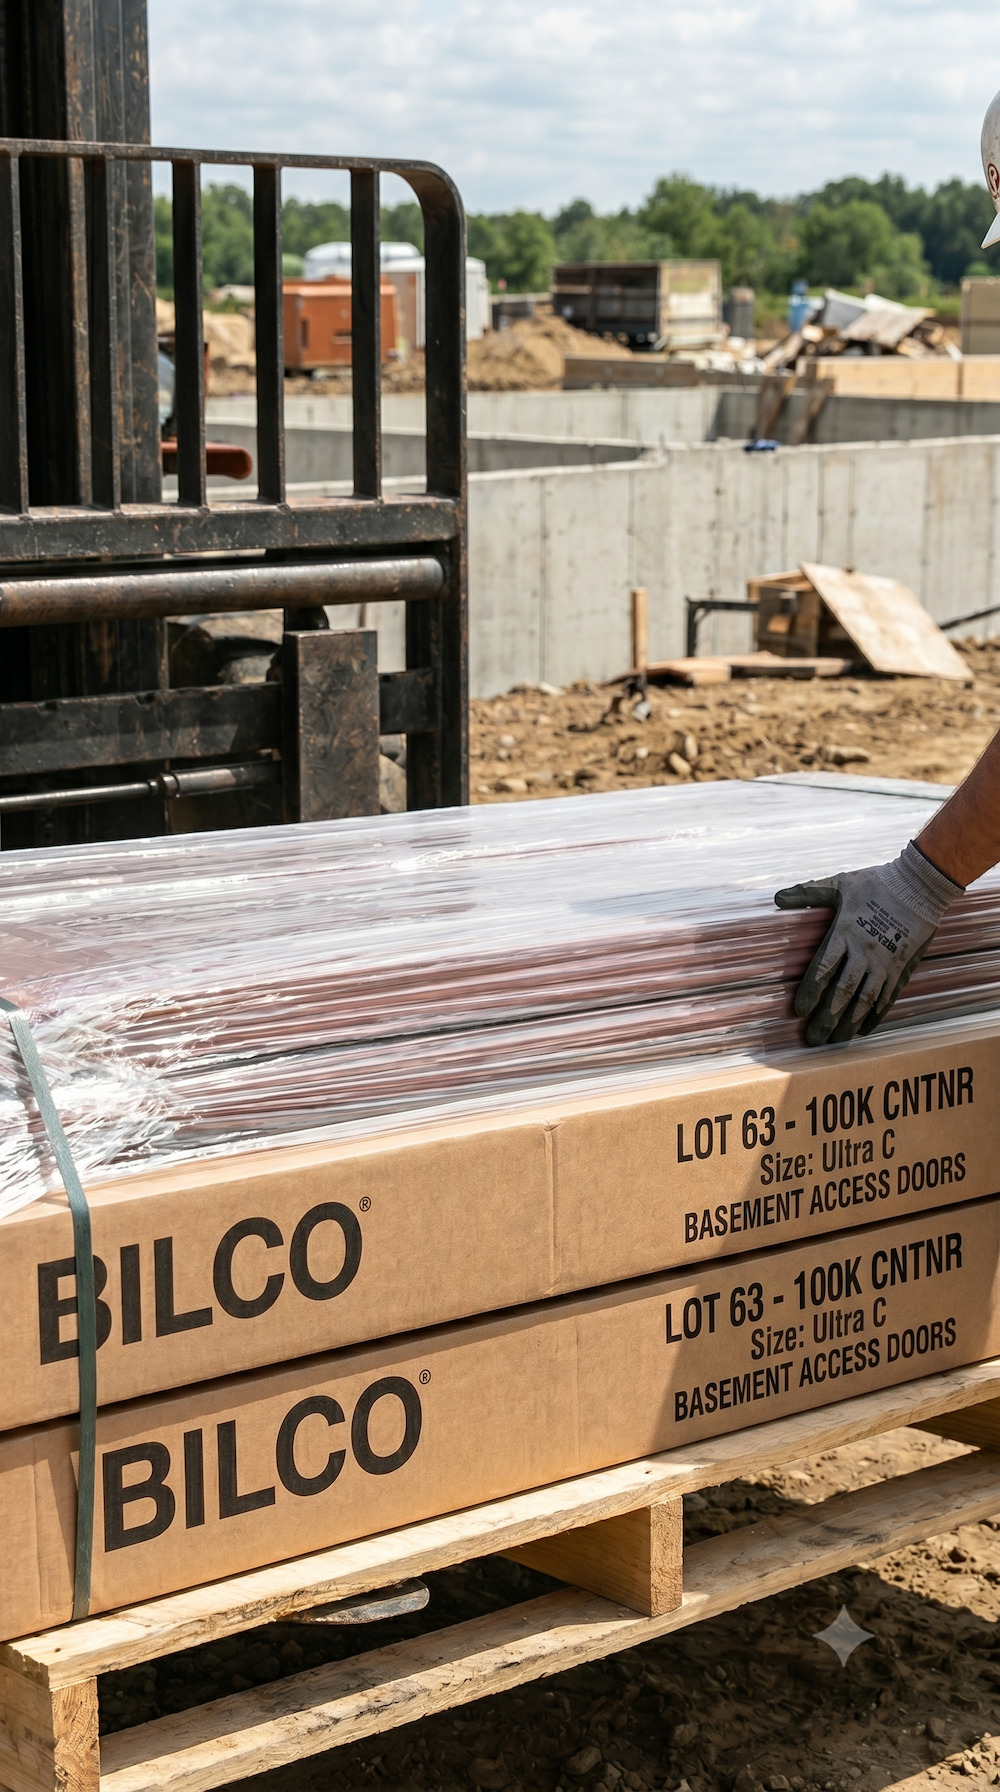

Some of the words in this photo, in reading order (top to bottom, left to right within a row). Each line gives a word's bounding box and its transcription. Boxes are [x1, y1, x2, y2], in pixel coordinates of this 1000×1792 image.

[677, 1113, 732, 1163] LOT
[742, 1106, 776, 1150] 63
[785, 1120, 796, 1130] -
[805, 1085, 874, 1136] 100K
[883, 1066, 974, 1121] CNTNR
[760, 1151, 813, 1186] Size:
[822, 1139, 874, 1172] Ultra
[882, 1128, 895, 1159] C
[684, 1188, 804, 1243] BASEMENT
[809, 1168, 890, 1215] ACCESS
[898, 1152, 966, 1195] DOORS
[665, 1292, 721, 1344] LOT
[729, 1282, 764, 1327] 63
[773, 1294, 784, 1305] -
[794, 1255, 863, 1310] 100K
[871, 1232, 963, 1290] CNTNR
[750, 1325, 804, 1360] Size:
[813, 1305, 864, 1344] Ultra
[873, 1297, 887, 1327] C
[674, 1361, 793, 1422] BASEMENT
[799, 1338, 880, 1387] ACCESS
[887, 1317, 957, 1363] DOORS
